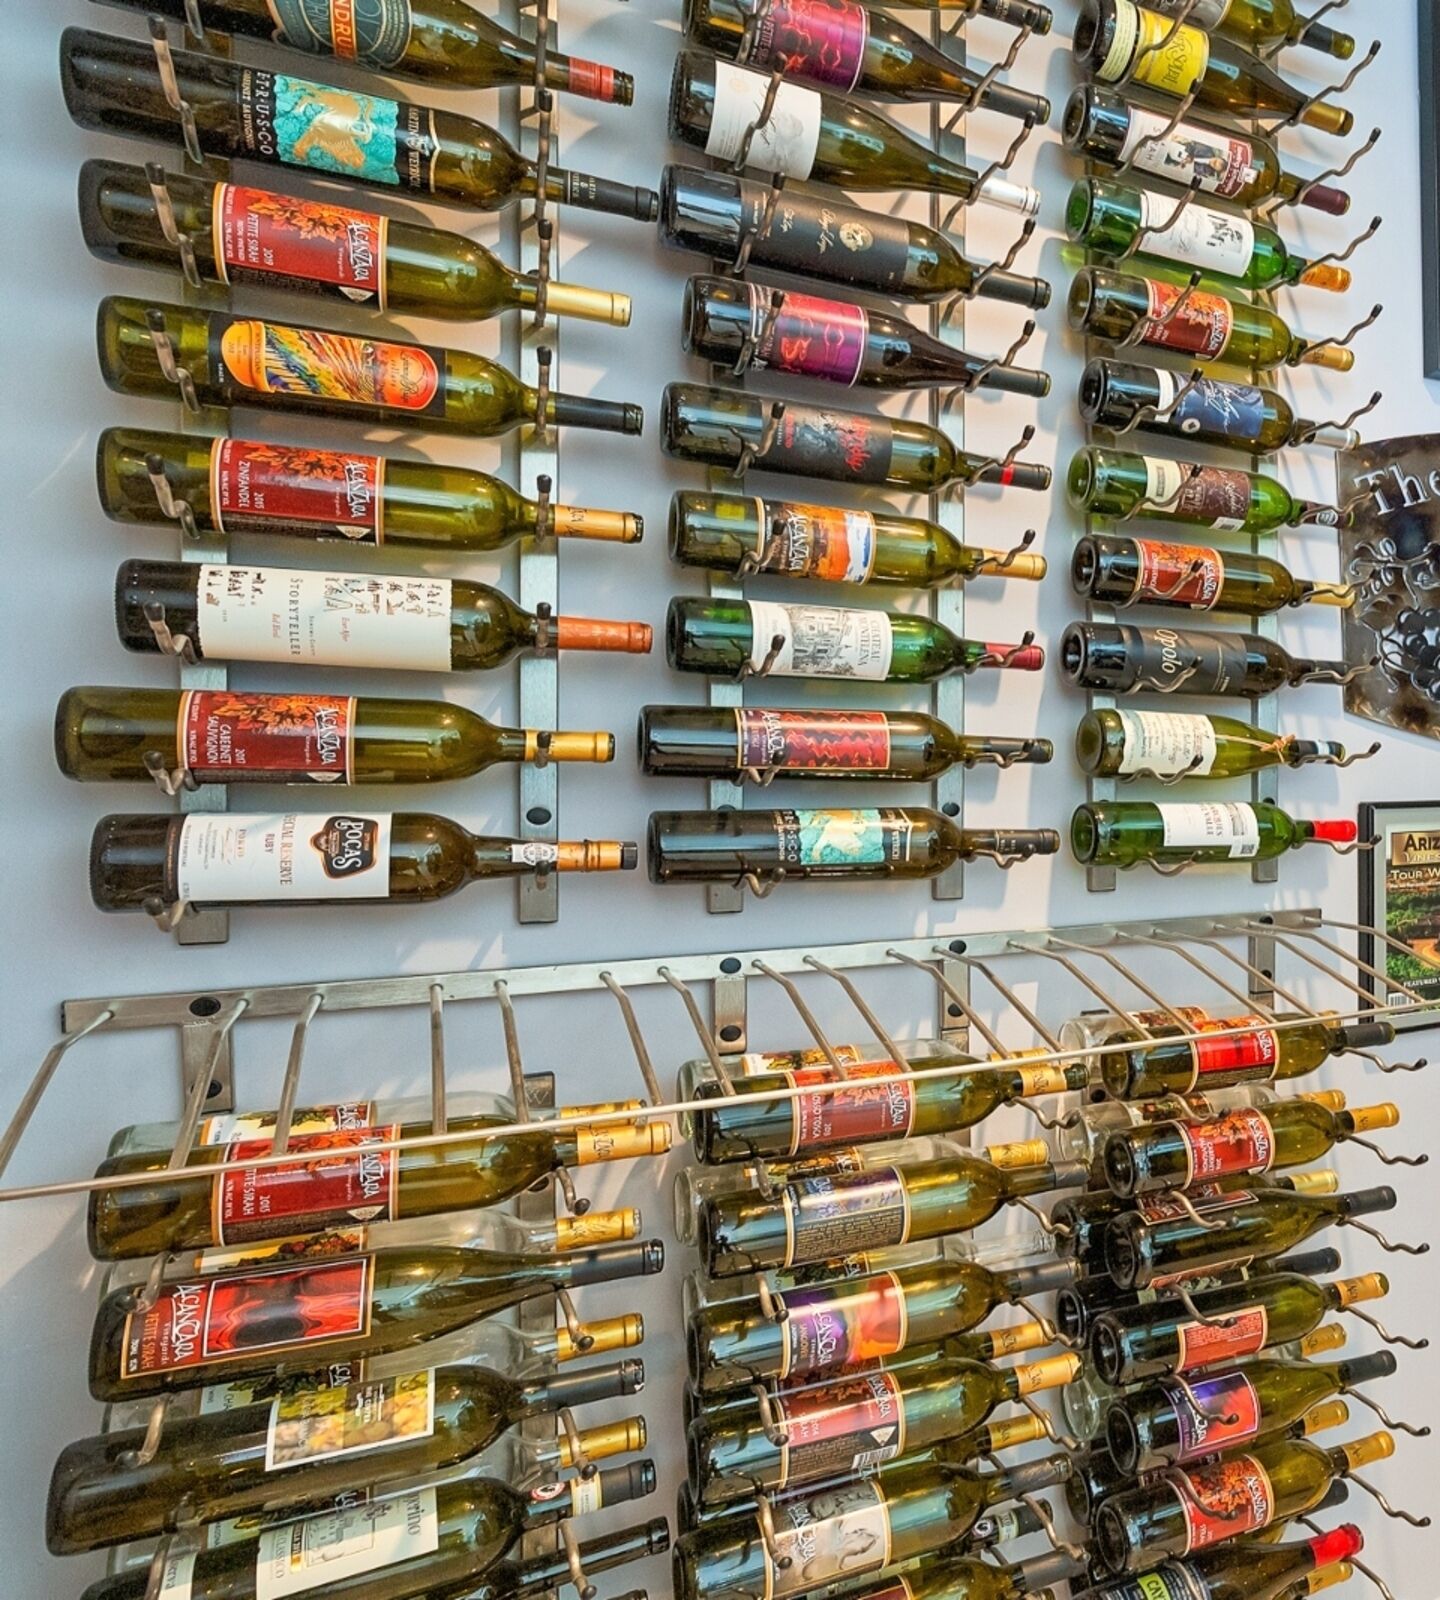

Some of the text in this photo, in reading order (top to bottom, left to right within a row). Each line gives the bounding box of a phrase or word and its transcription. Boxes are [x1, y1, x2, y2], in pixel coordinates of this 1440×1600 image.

[246, 213, 259, 264] PETITE SIRAH
[238, 459, 251, 510] ZINFANDEL
[288, 576, 304, 657] STORYTELLER
[869, 618, 881, 664] CHATEAU
[1154, 628, 1184, 675] Opolo
[207, 715, 220, 765] SAUVIGNON
[220, 723, 232, 765] CABERNET
[264, 832, 276, 854] RUBY
[279, 842, 294, 885] RESERVE
[331, 818, 365, 870] POÇAS
[1388, 867, 1423, 881] TOUR
[811, 1092, 823, 1117] OSSO
[242, 1190, 256, 1217] SIRAH
[142, 1312, 160, 1370] PETITE SIRAH
[159, 1320, 170, 1366] Vineyards
